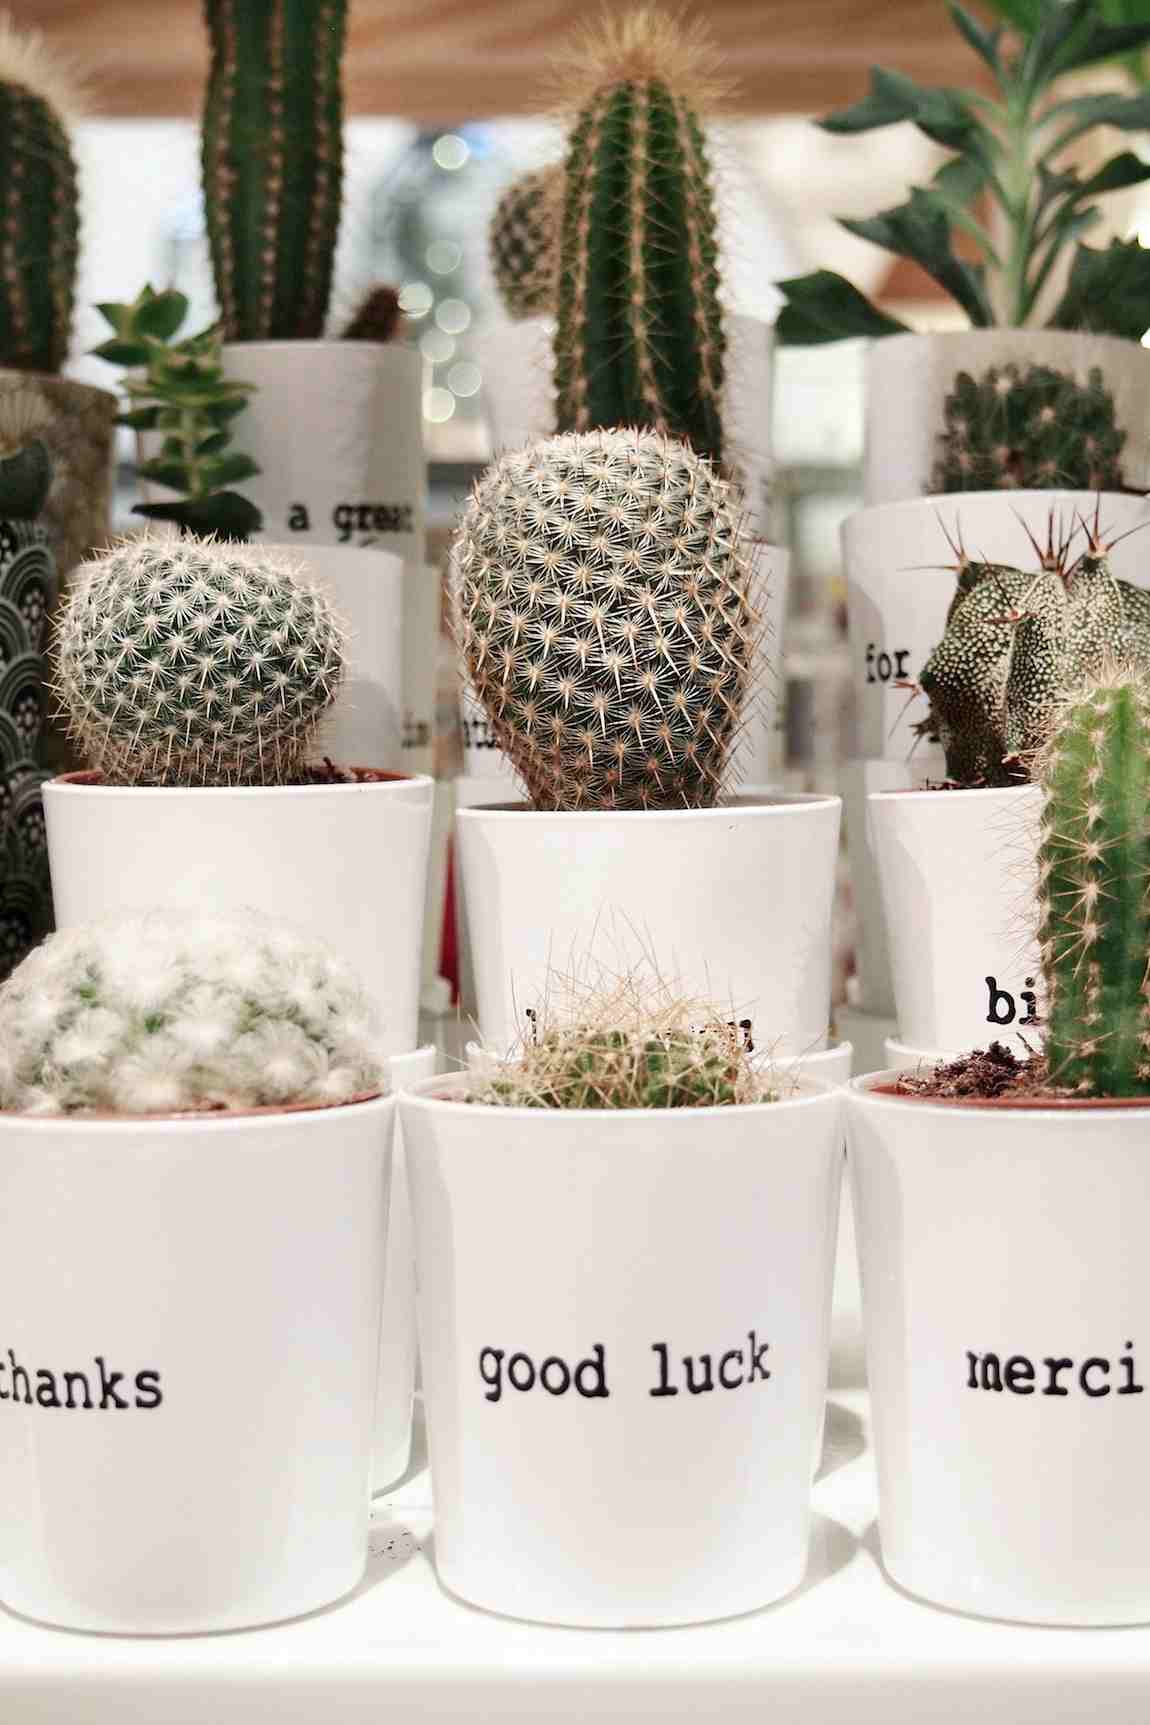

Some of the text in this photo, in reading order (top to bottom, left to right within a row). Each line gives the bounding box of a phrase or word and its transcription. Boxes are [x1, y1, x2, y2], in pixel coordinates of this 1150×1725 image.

[288, 504, 310, 531] a
[984, 976, 1039, 1025] bi
[480, 1331, 770, 1402] good luck
[966, 1341, 1144, 1397] merci
